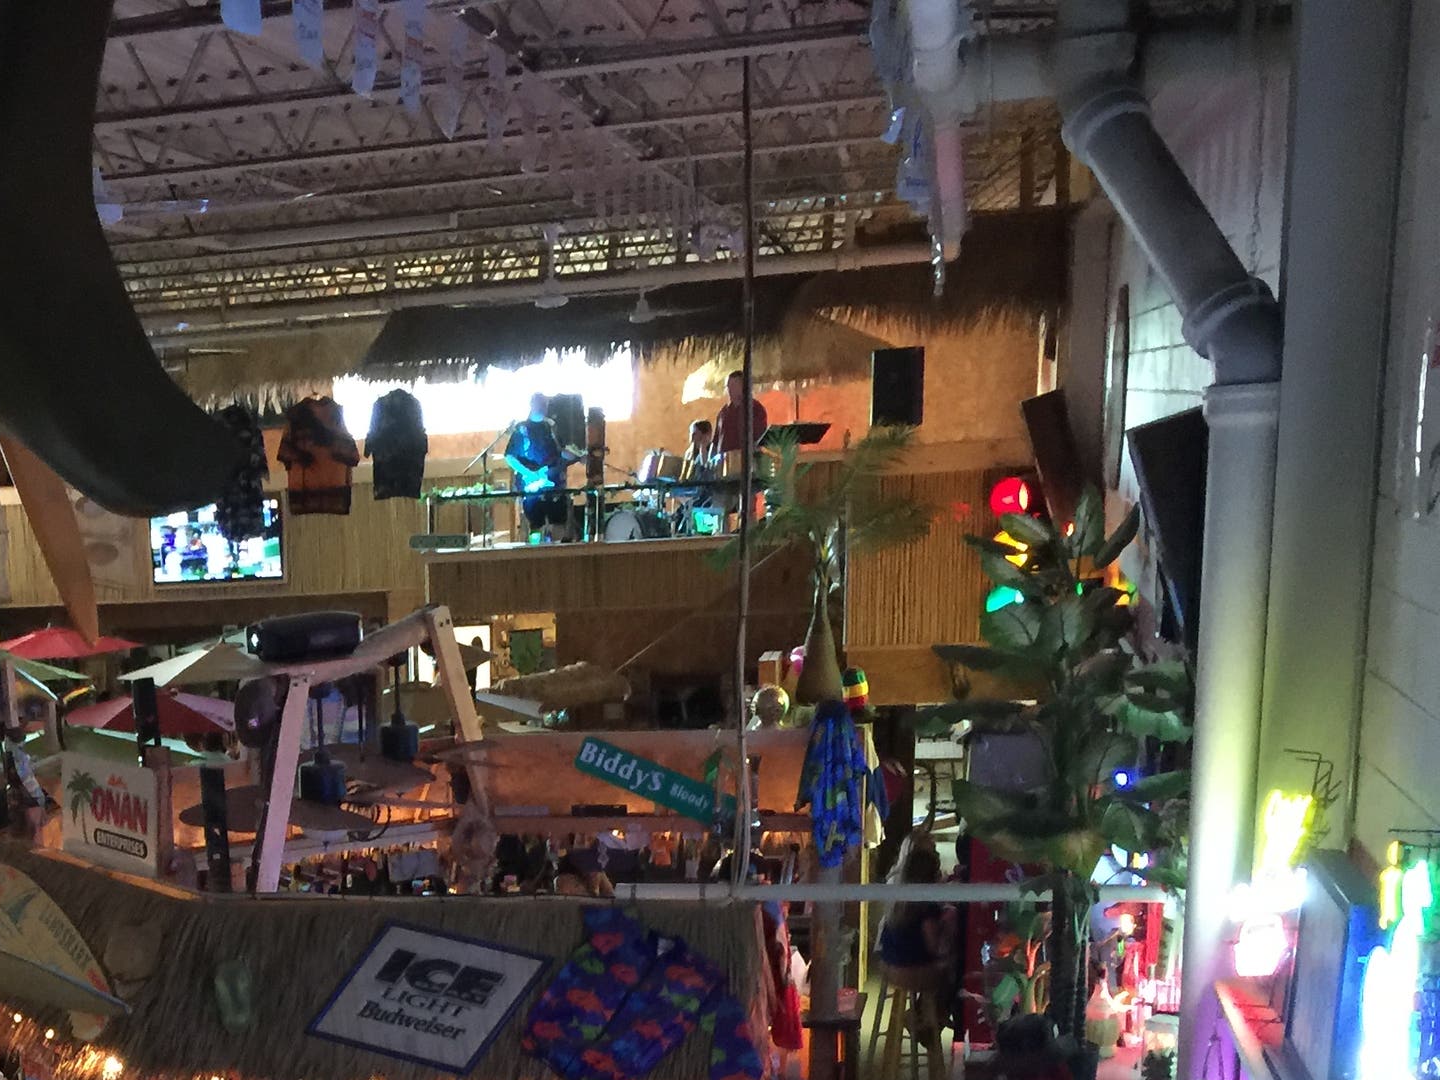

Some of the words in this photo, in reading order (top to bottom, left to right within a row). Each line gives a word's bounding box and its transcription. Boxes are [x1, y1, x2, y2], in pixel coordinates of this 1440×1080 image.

[91, 787, 148, 834] ONAN
[374, 948, 507, 1007] ICE
[357, 1000, 467, 1040] Budweiser
[382, 986, 472, 1017] LIGHT
